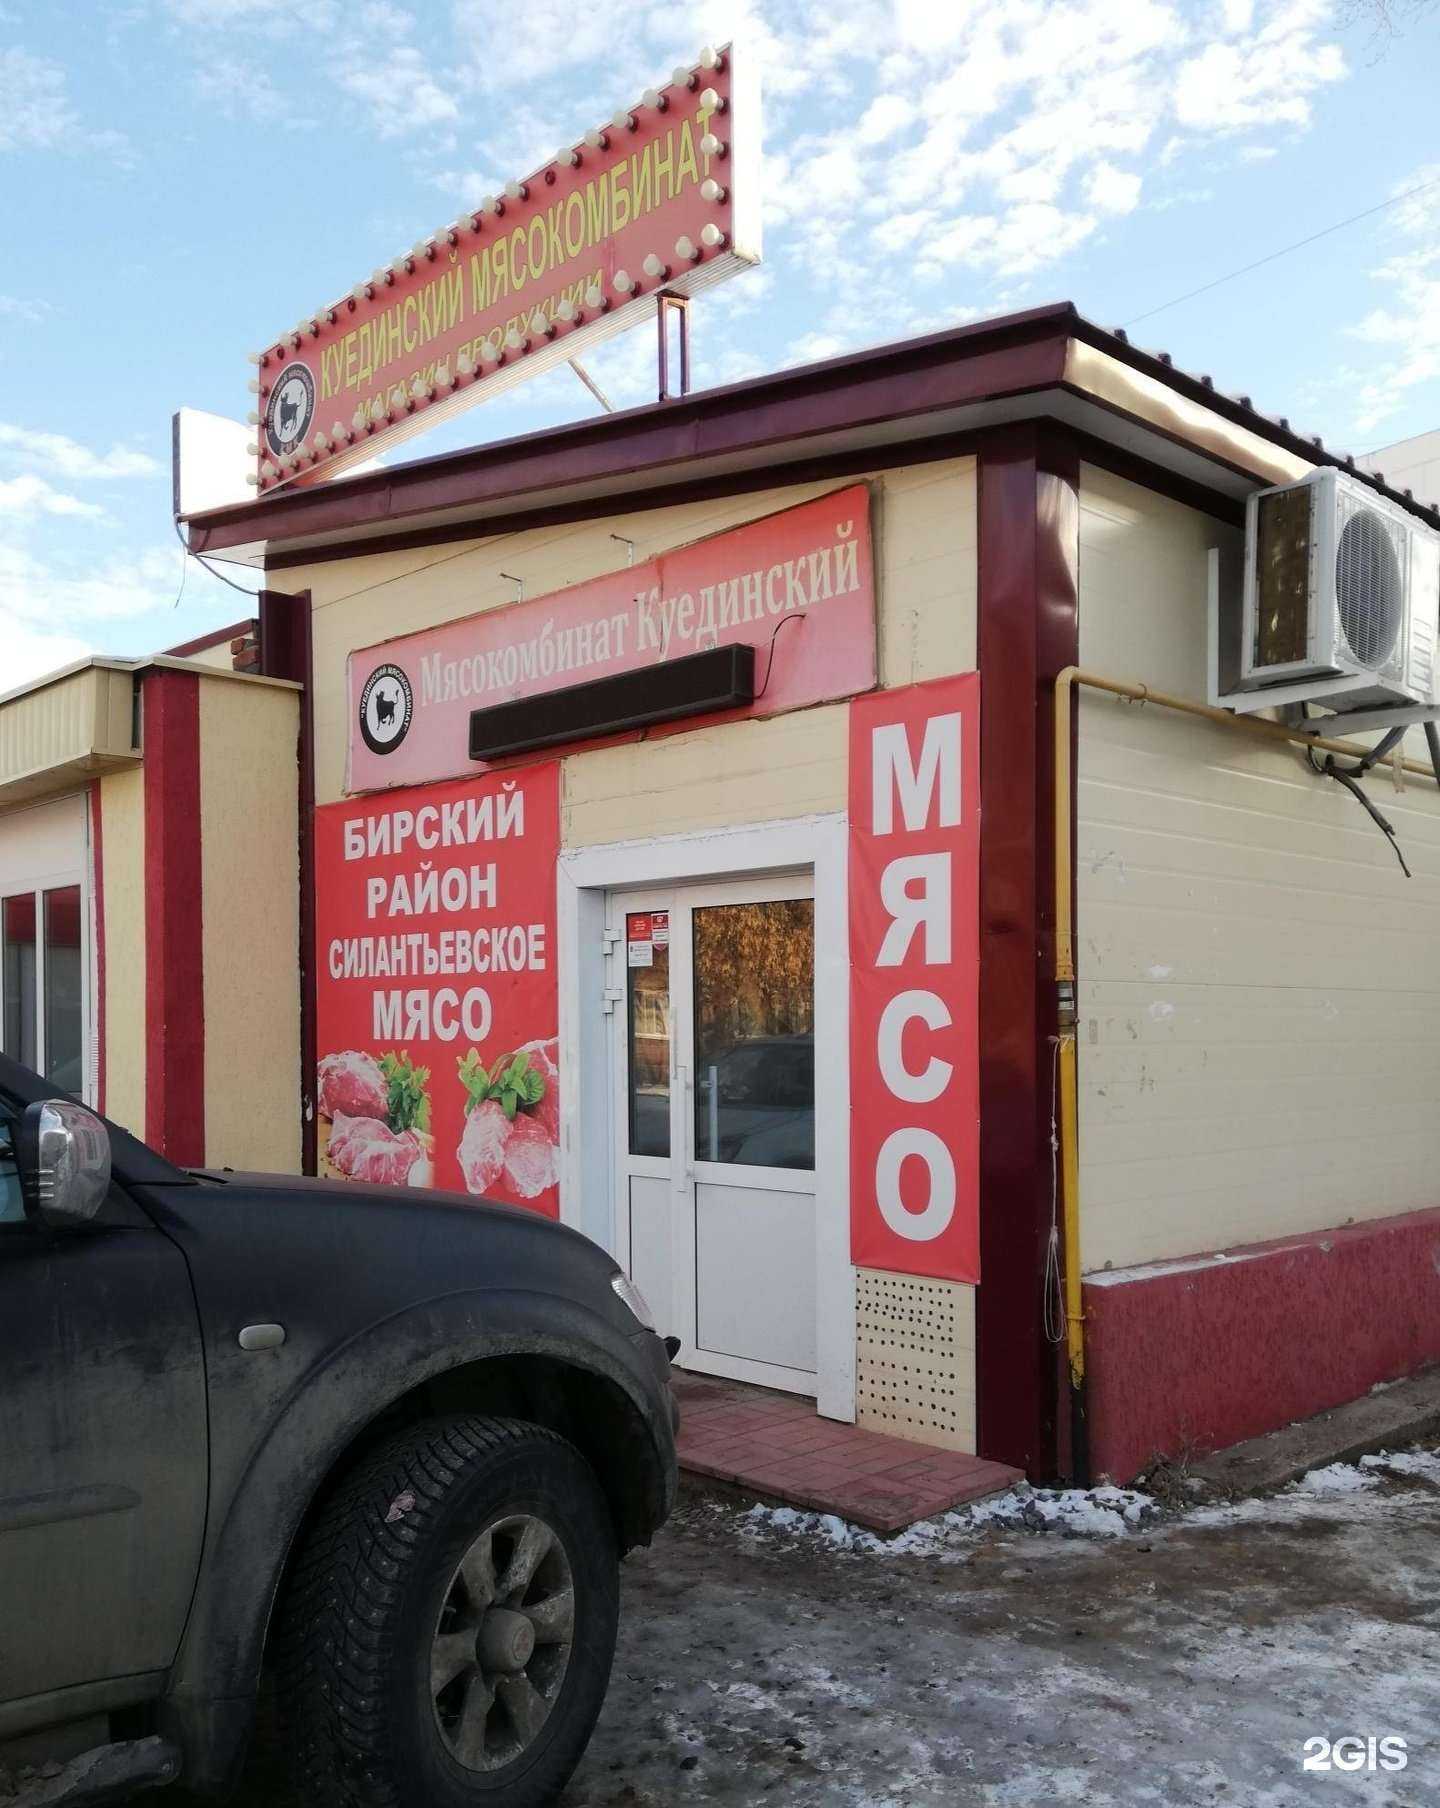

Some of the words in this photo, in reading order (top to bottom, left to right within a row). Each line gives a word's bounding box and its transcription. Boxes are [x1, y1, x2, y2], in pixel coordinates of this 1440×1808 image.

[320, 247, 464, 402] КУЕДИНСКИЙ
[470, 104, 715, 316] МЯСОКОМБИНАТ
[420, 616, 630, 707] Мясокомбинат
[635, 519, 861, 662] Куединский
[344, 780, 525, 861] БИРСКИЙ
[367, 861, 497, 919] РАЙОН
[329, 923, 546, 980] СИЛАНТЬЕВСКОЕ
[872, 711, 962, 1242] МЯСО
[373, 987, 492, 1041] МЯСО
